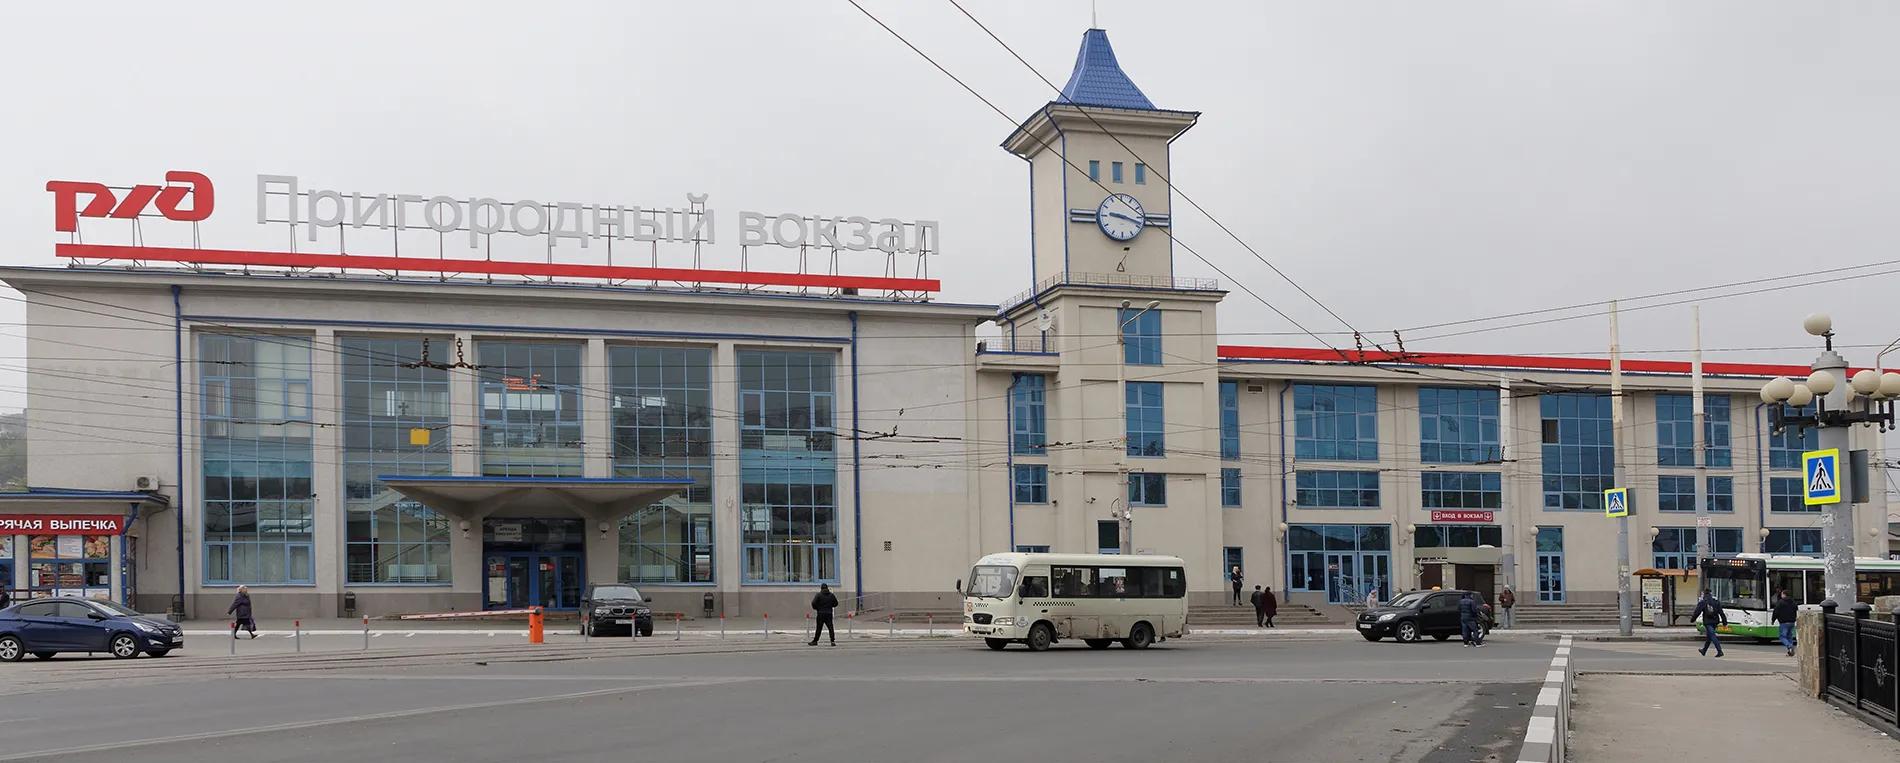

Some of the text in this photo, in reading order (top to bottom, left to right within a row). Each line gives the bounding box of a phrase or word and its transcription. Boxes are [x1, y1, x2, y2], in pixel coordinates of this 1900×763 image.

[257, 174, 939, 256] Пригородный вокзал
[50, 519, 117, 530] ВЫПЕЧКА
